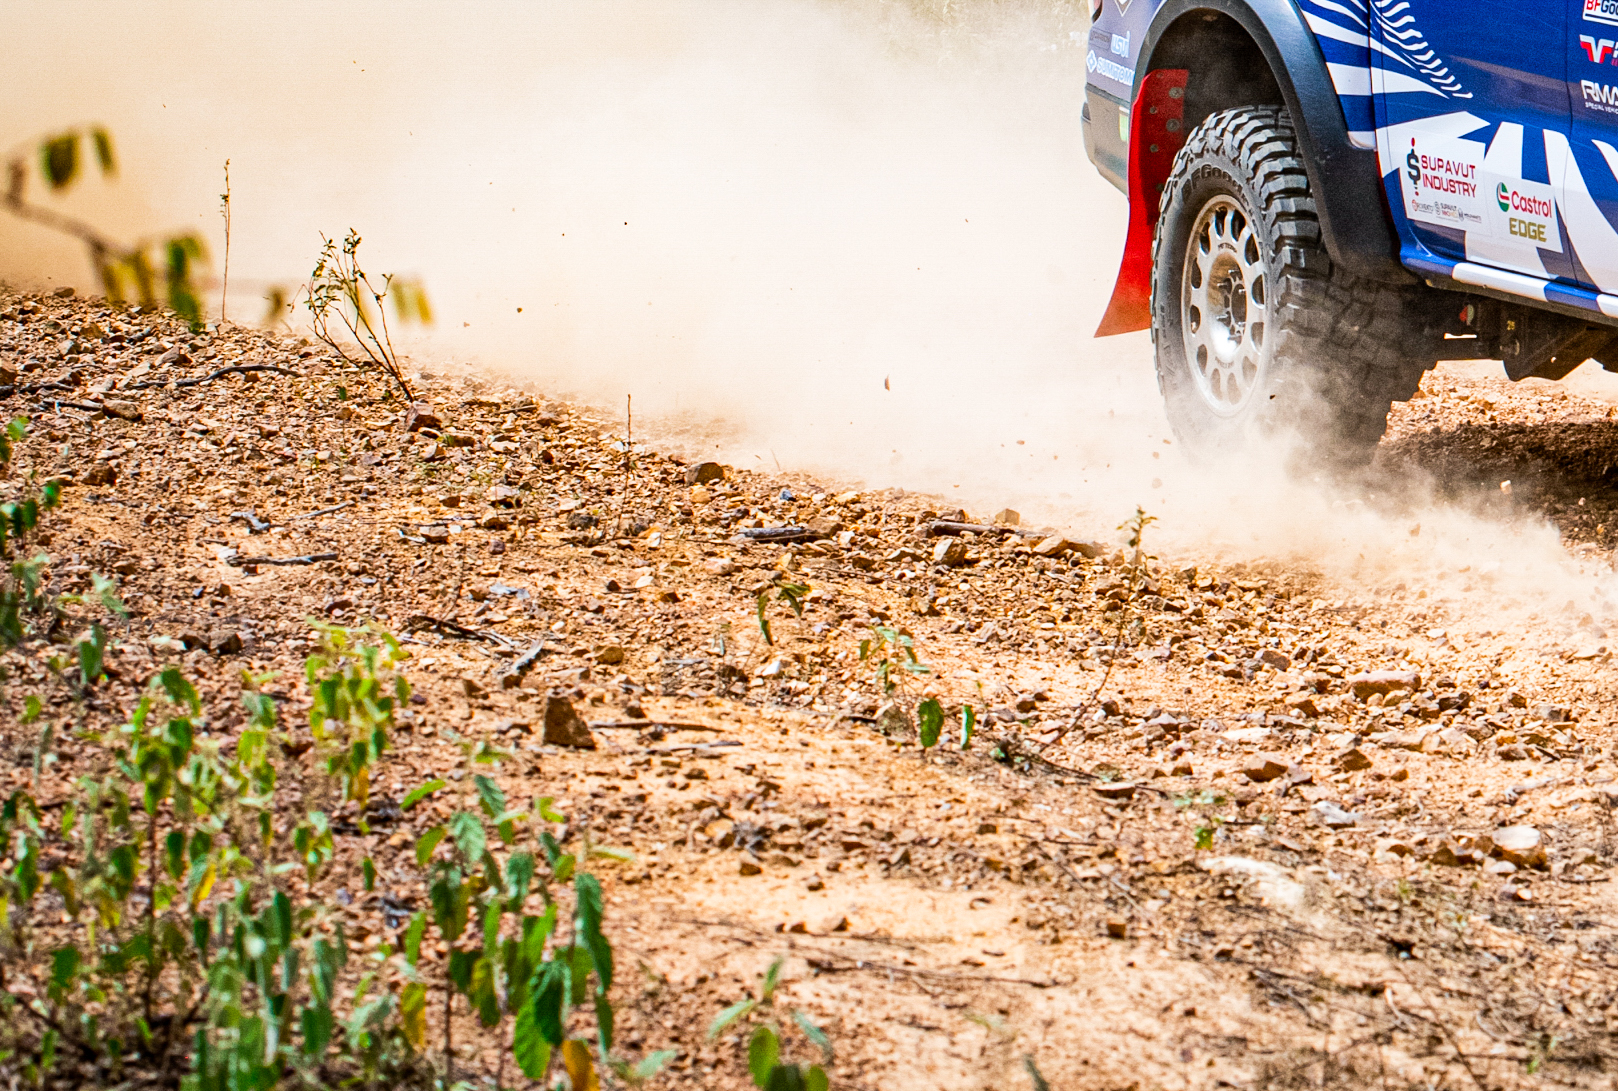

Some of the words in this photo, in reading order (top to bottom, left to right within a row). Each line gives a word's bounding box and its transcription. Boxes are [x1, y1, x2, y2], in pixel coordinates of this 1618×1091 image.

[1421, 154, 1476, 180] SUPAVUT
[1422, 173, 1477, 198] INDUSTRY
[1511, 190, 1552, 219] Castrol
[1509, 217, 1547, 243] EDGE
